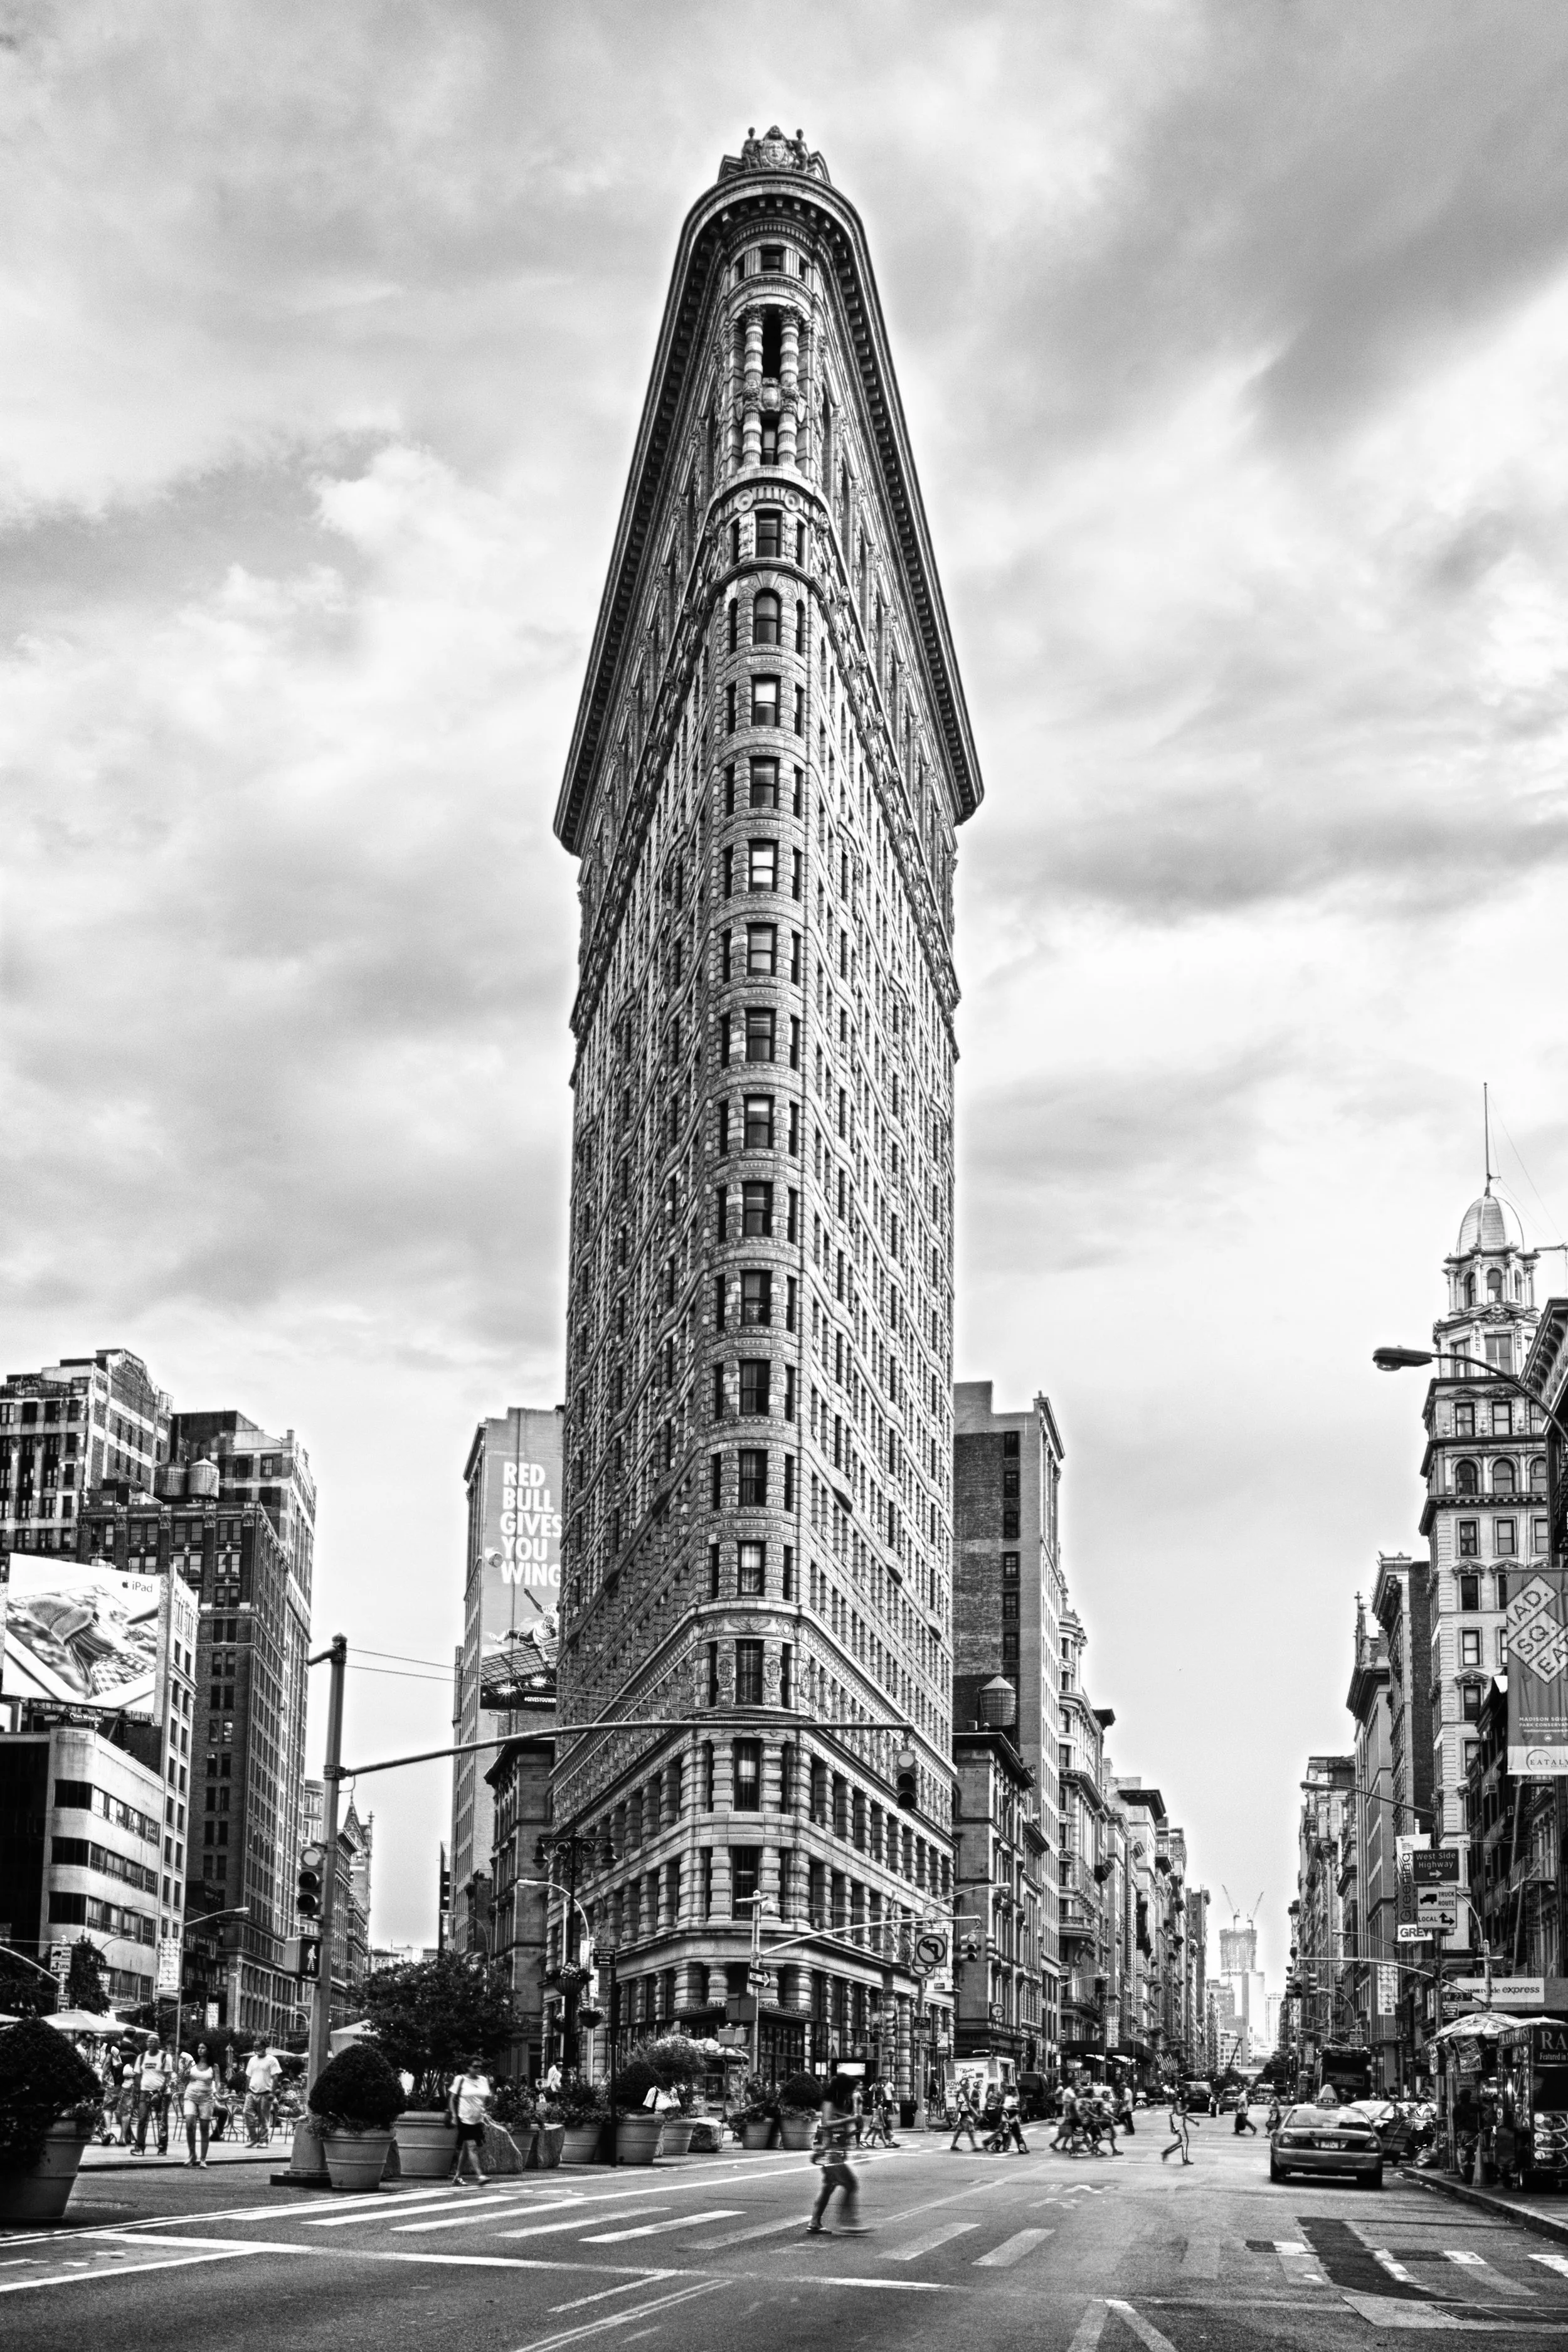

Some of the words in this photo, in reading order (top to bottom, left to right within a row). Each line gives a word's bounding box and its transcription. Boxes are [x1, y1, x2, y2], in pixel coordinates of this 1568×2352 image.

[503, 1461, 546, 1487] RED
[502, 1487, 554, 1512] BULL
[500, 1512, 562, 1537] GIVES
[501, 1535, 548, 1561] YOU
[501, 1561, 561, 1587] WING
[132, 1581, 152, 1593] iPad
[1517, 1625, 1555, 1655] SQ.
[1418, 1860, 1453, 1870] Highway
[1400, 1853, 1412, 1922] Greening
[1445, 1993, 1451, 2001] W
[1454, 1993, 1463, 2001] 23
[1502, 1986, 1540, 1995] express
[1540, 2031, 1568, 2050] RA
[1539, 2052, 1560, 2060] Featured
[1561, 2052, 1566, 2060] in
